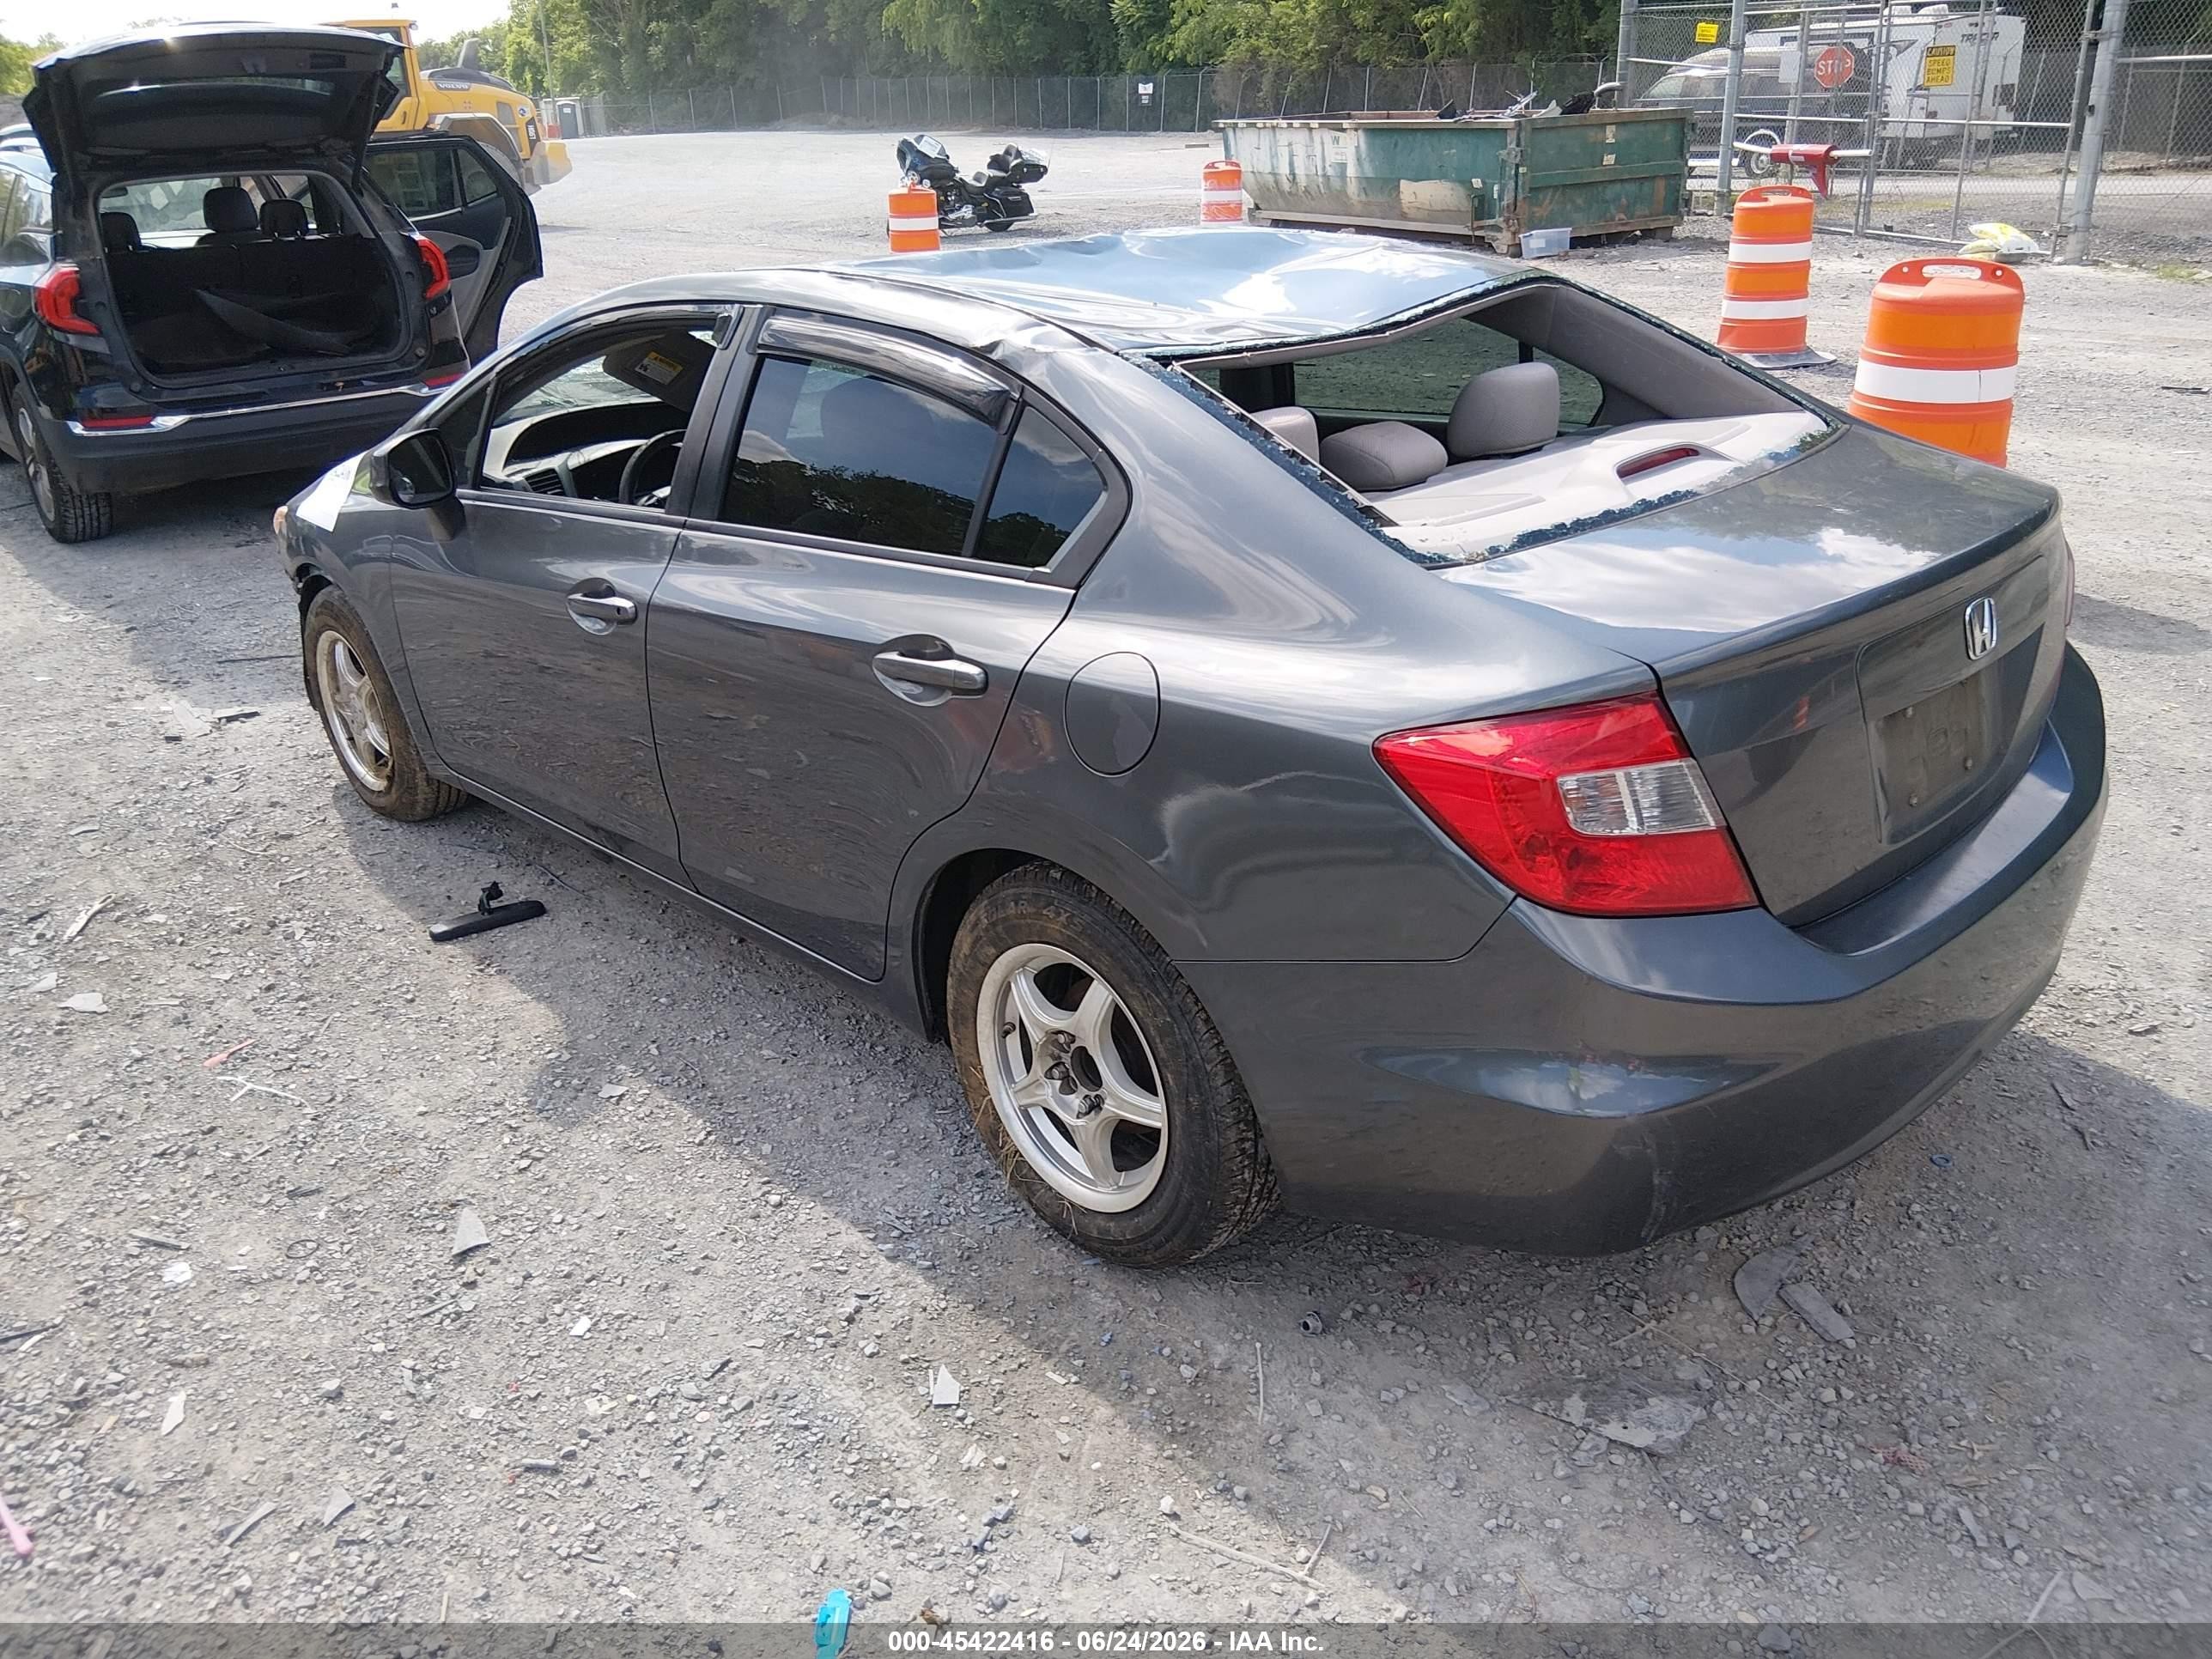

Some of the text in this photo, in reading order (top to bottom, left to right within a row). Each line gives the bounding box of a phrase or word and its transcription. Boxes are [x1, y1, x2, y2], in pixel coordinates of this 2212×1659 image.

[1926, 46, 1955, 56] CAUTION
[1817, 58, 1851, 76] STOP
[1928, 58, 1951, 67] SPEED
[1926, 67, 1952, 76] BUMPS
